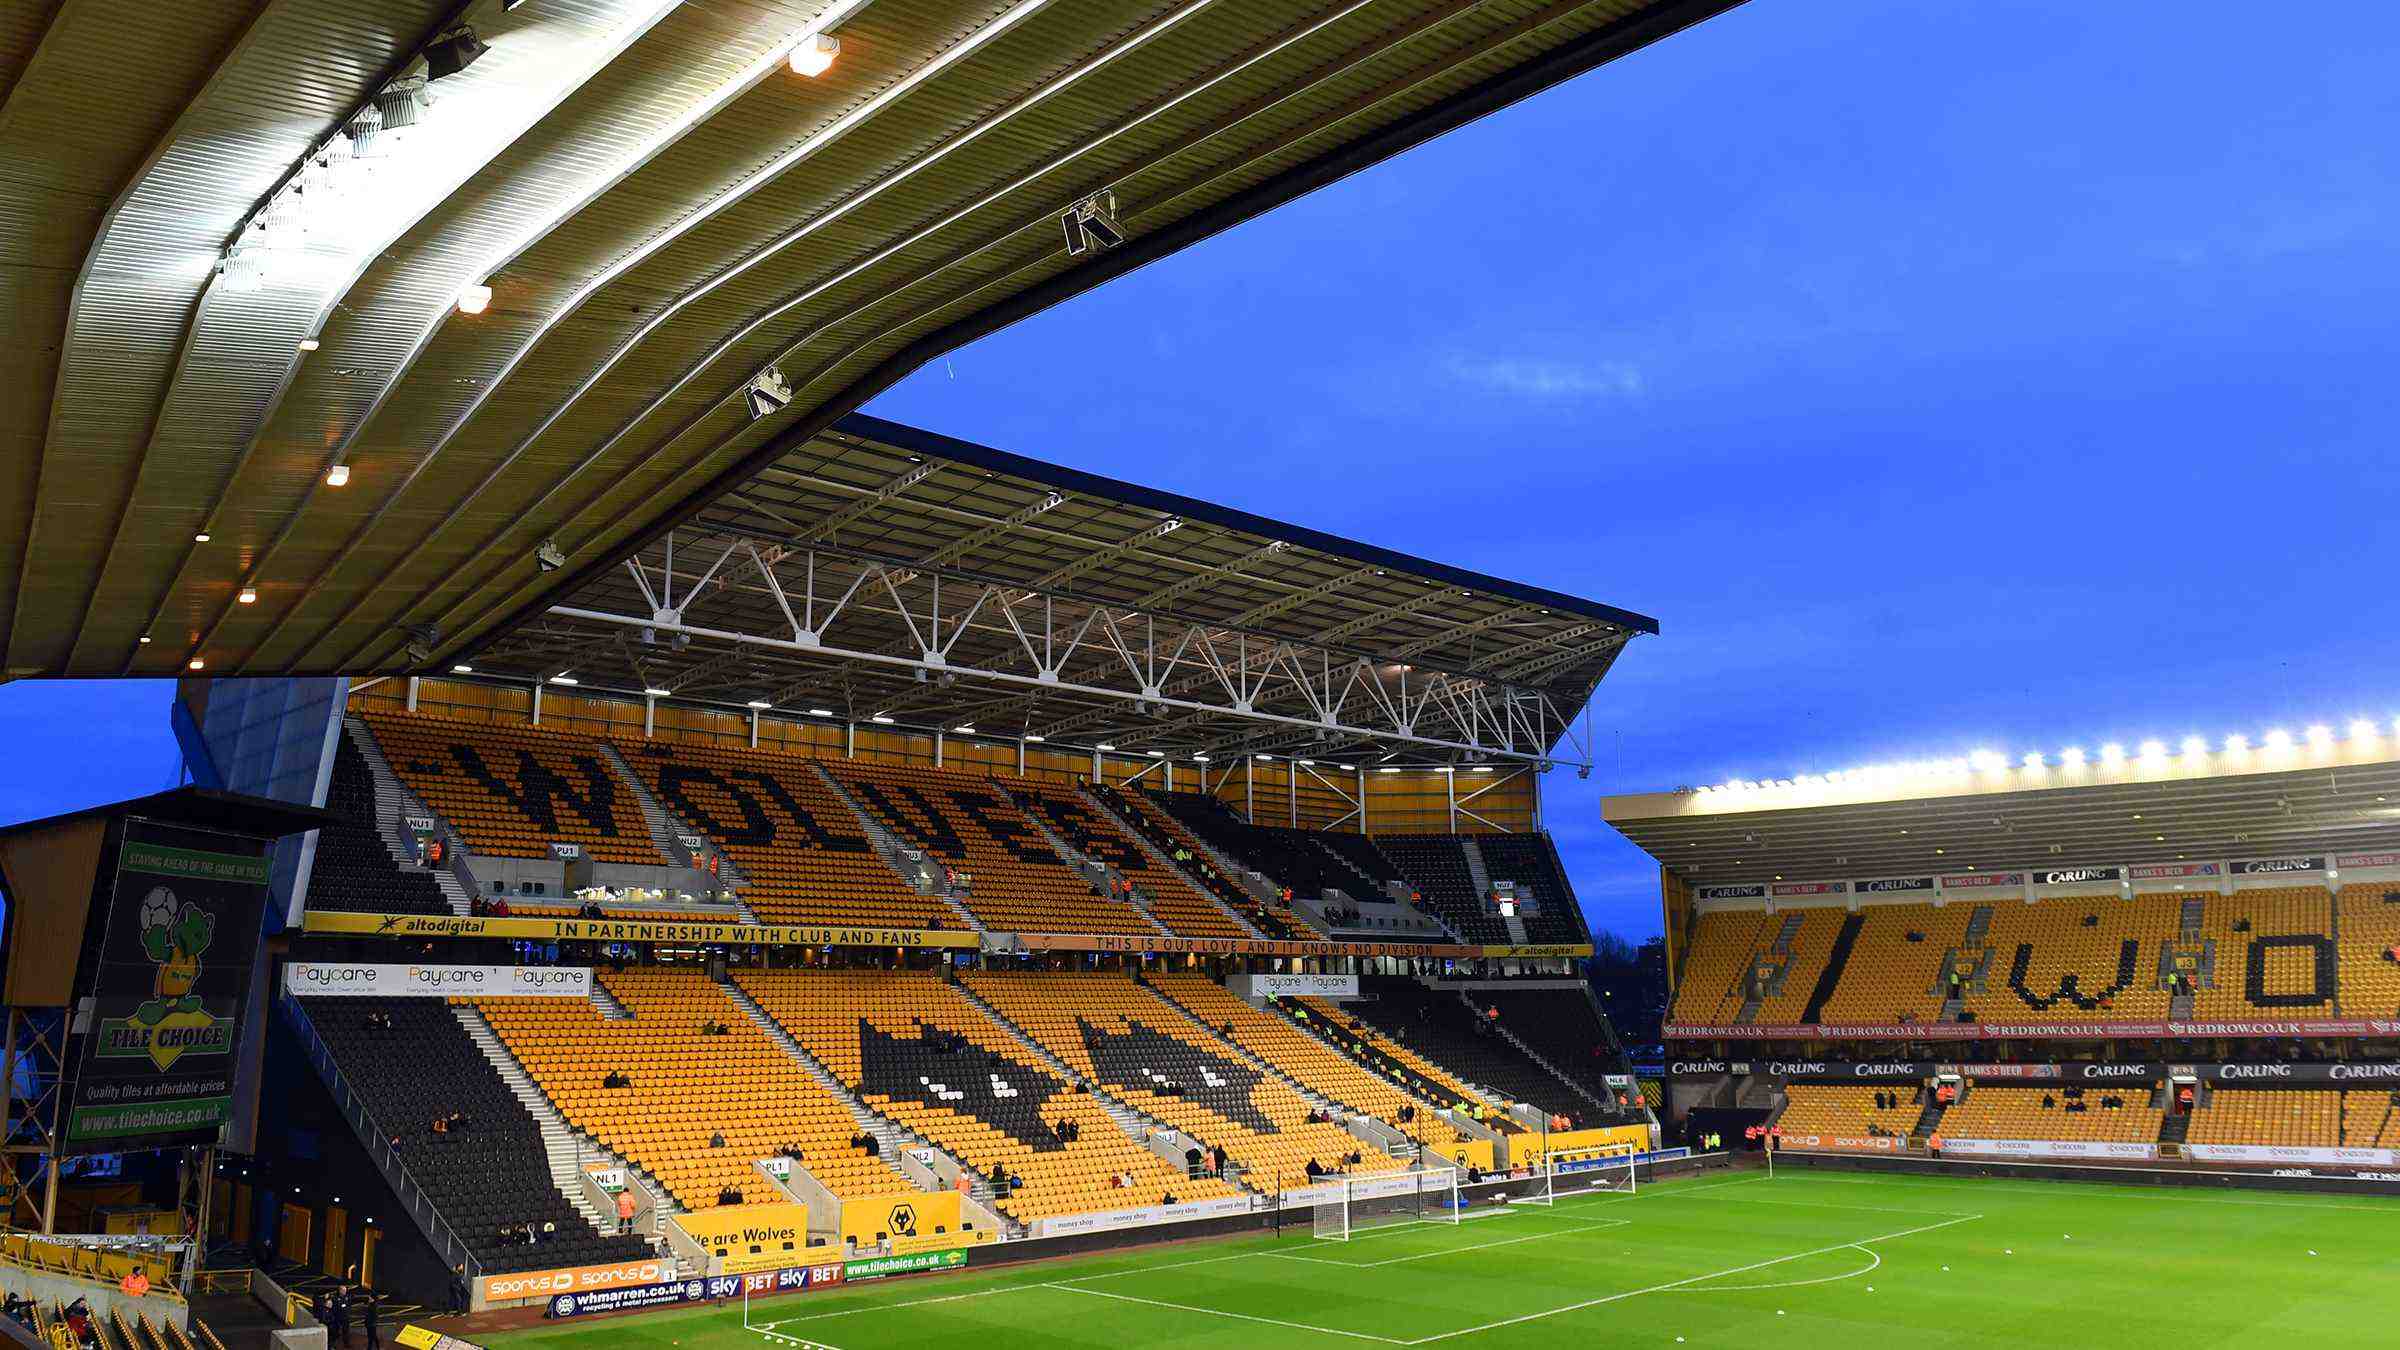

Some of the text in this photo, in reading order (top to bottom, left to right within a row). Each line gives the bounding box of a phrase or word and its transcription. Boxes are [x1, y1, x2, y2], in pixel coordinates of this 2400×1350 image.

[409, 818, 430, 828] NU1
[557, 846, 575, 856] PU1
[2245, 859, 2310, 873] CARLING
[2047, 870, 2106, 884] CARLING
[1707, 886, 1757, 899] CARLING
[1868, 879, 1921, 892] CARLING
[406, 918, 485, 935] altodigital
[555, 922, 922, 944] IN PARTNERSHIP WITH CLUB AND FANS
[1096, 937, 1432, 955] THIS IS OUR LOVE AND IT KNOWS NO DIVISION
[1524, 946, 1574, 956] altodigital
[296, 965, 376, 985] Paycare
[409, 966, 484, 986] Paycare
[514, 968, 583, 987] Paycare
[1265, 976, 1301, 989] Paycare
[1313, 976, 1347, 989] Paycare
[1678, 1027, 1764, 1037] REDROW.CO.UK
[1832, 1027, 1926, 1037] REDROW.CO.UK
[2001, 1026, 2103, 1036] REDROW.CO.UK
[2187, 1024, 2300, 1034] REDROW.CO.UK
[111, 1028, 223, 1048] TILE CHOICE
[1671, 1062, 1725, 1074] CARLING
[1769, 1062, 1825, 1075] CARLING
[1855, 1063, 1914, 1076] CARLING
[2084, 1064, 2145, 1078] CARLING
[2220, 1064, 2291, 1079] CARLING
[2329, 1064, 2400, 1079] CARLING
[87, 1079, 225, 1100] Quality tiles at affordable prices
[80, 1105, 219, 1131] www.tilechoice.co.uk
[766, 1162, 782, 1172] PL1
[597, 1172, 617, 1184] NL1
[714, 1232, 738, 1246] are
[743, 1225, 795, 1243] Wolves
[847, 1254, 939, 1276] www.tilechoice.co.uk
[582, 1267, 637, 1285] sports
[779, 1269, 807, 1287] sky
[812, 1266, 841, 1283] BET
[491, 1277, 550, 1295] sports
[711, 1274, 774, 1297] sky BET
[577, 1283, 685, 1305] whmarren.co.uk
[583, 1302, 613, 1313] recycling
[622, 1298, 641, 1308] metal
[643, 1295, 679, 1307] processors
